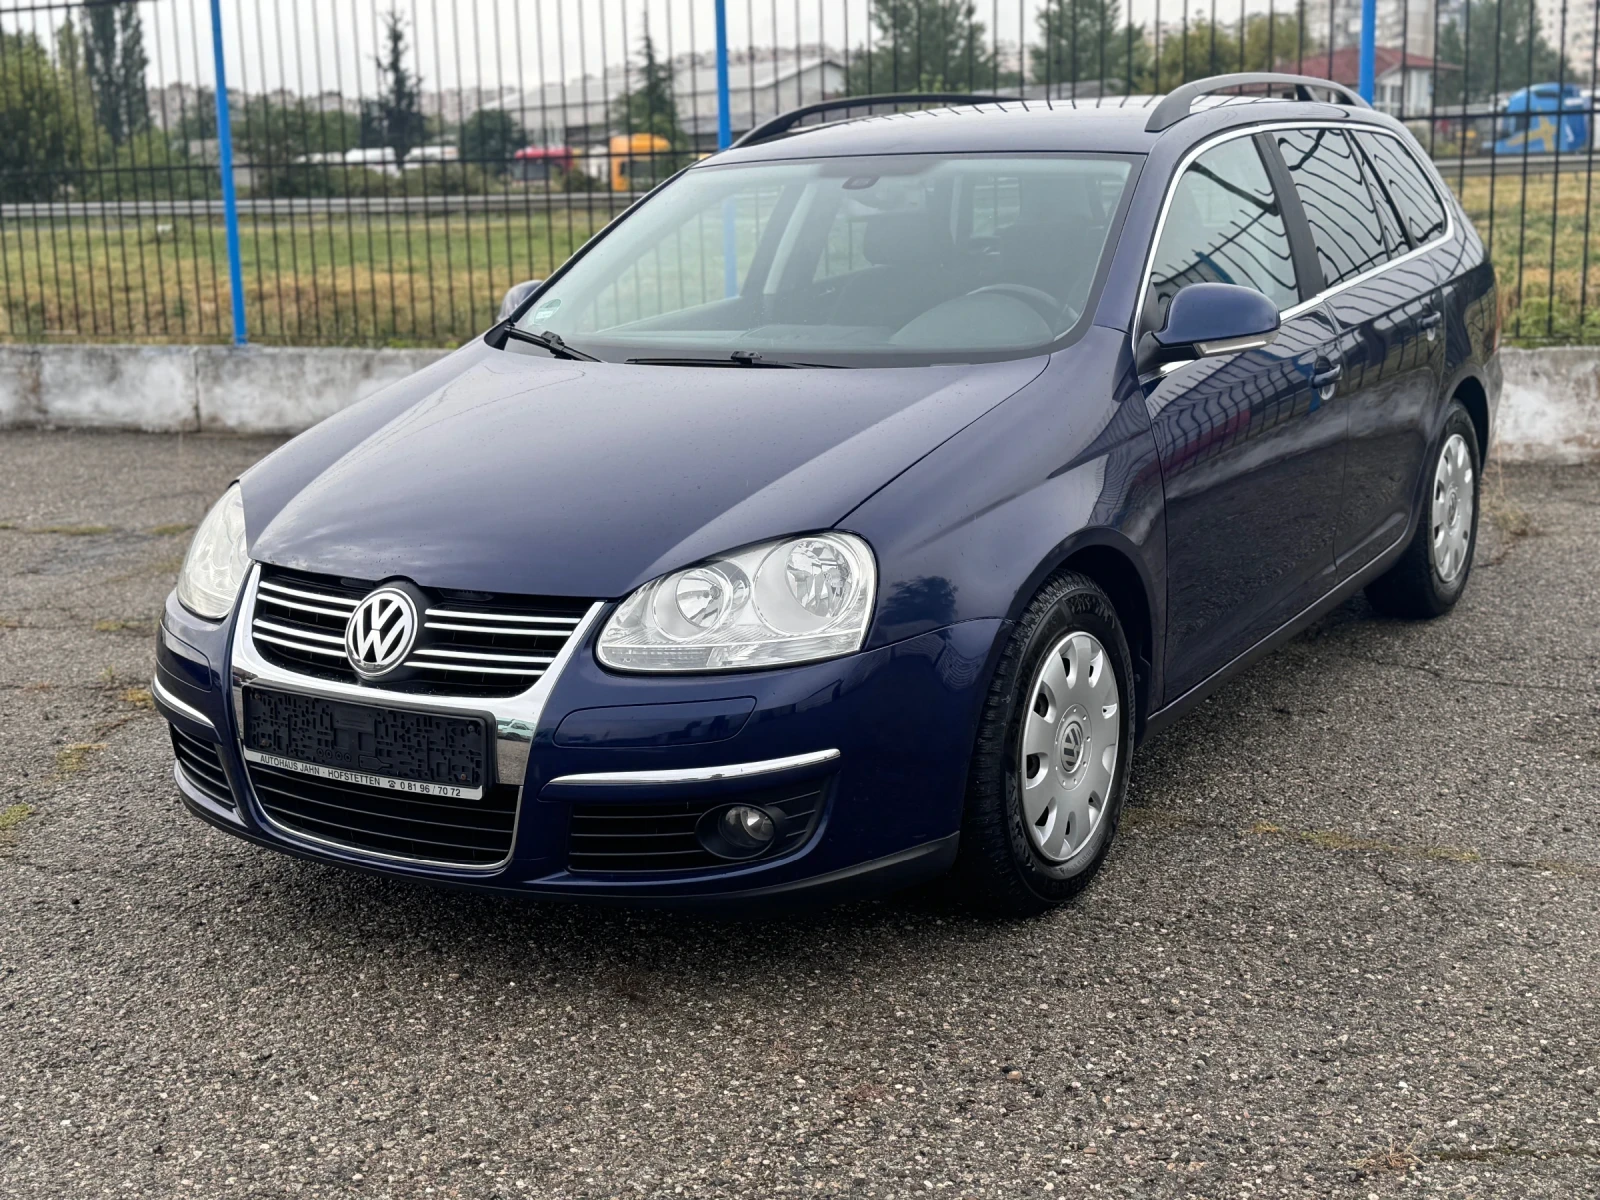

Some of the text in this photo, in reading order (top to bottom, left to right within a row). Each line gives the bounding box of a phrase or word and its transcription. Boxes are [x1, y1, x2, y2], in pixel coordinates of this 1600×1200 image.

[347, 590, 416, 671] VW
[260, 754, 298, 771] AUTOHAUS
[300, 763, 320, 776] JAHN
[327, 769, 380, 786] HOFSTETTEN
